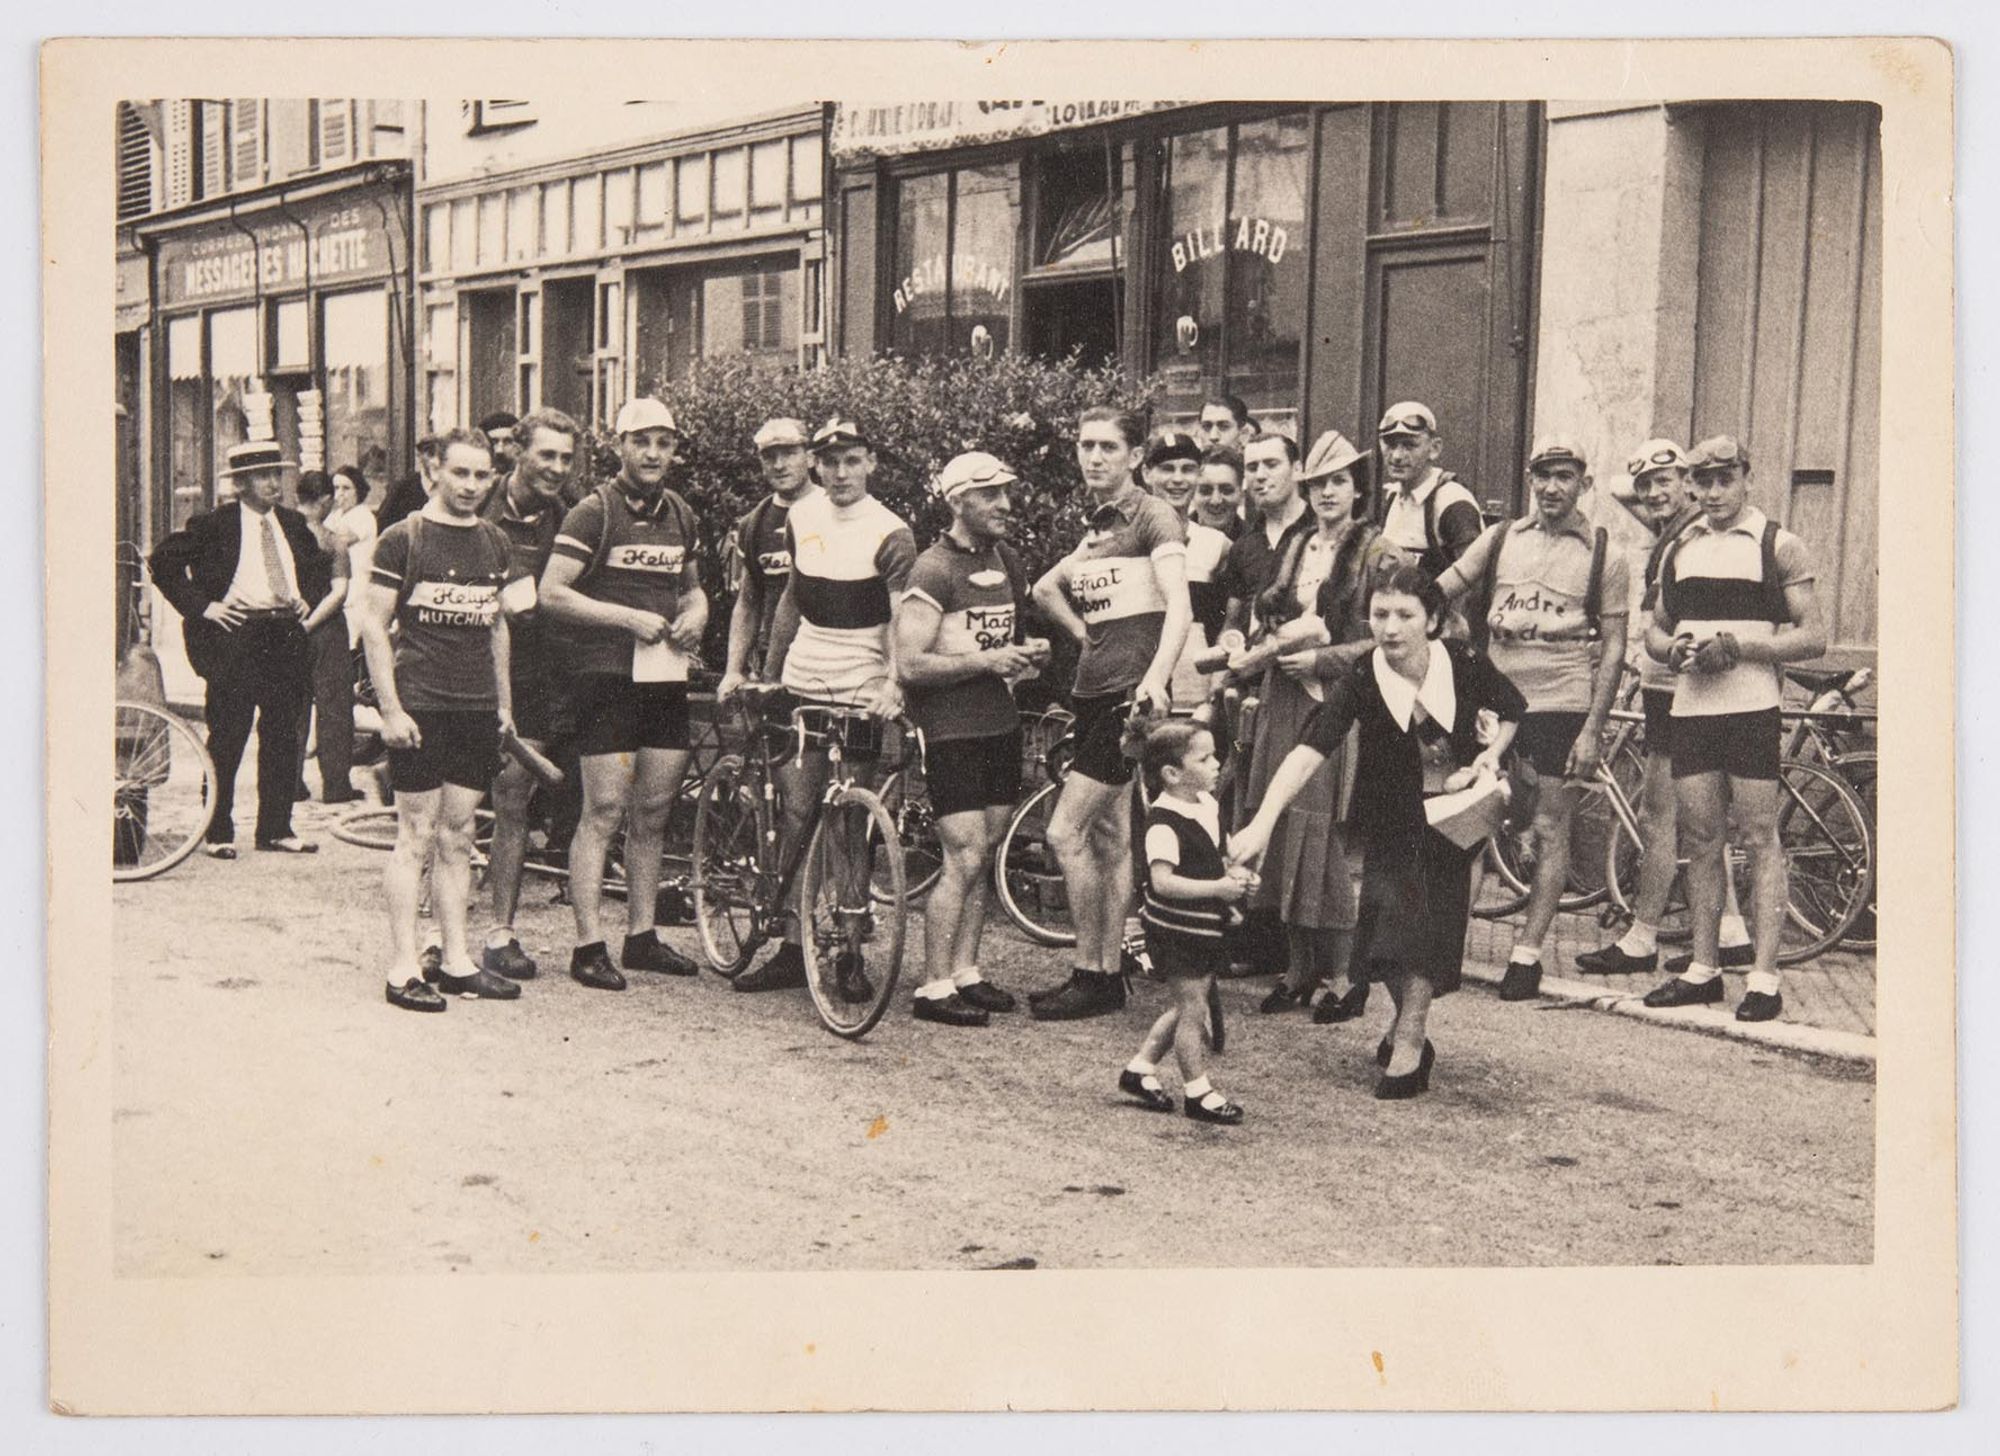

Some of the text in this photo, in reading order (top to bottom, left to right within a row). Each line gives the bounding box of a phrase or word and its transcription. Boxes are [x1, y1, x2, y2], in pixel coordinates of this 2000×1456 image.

[330, 207, 360, 228] DES
[1172, 216, 1287, 272] BILLARD
[966, 610, 1014, 637] Mag
